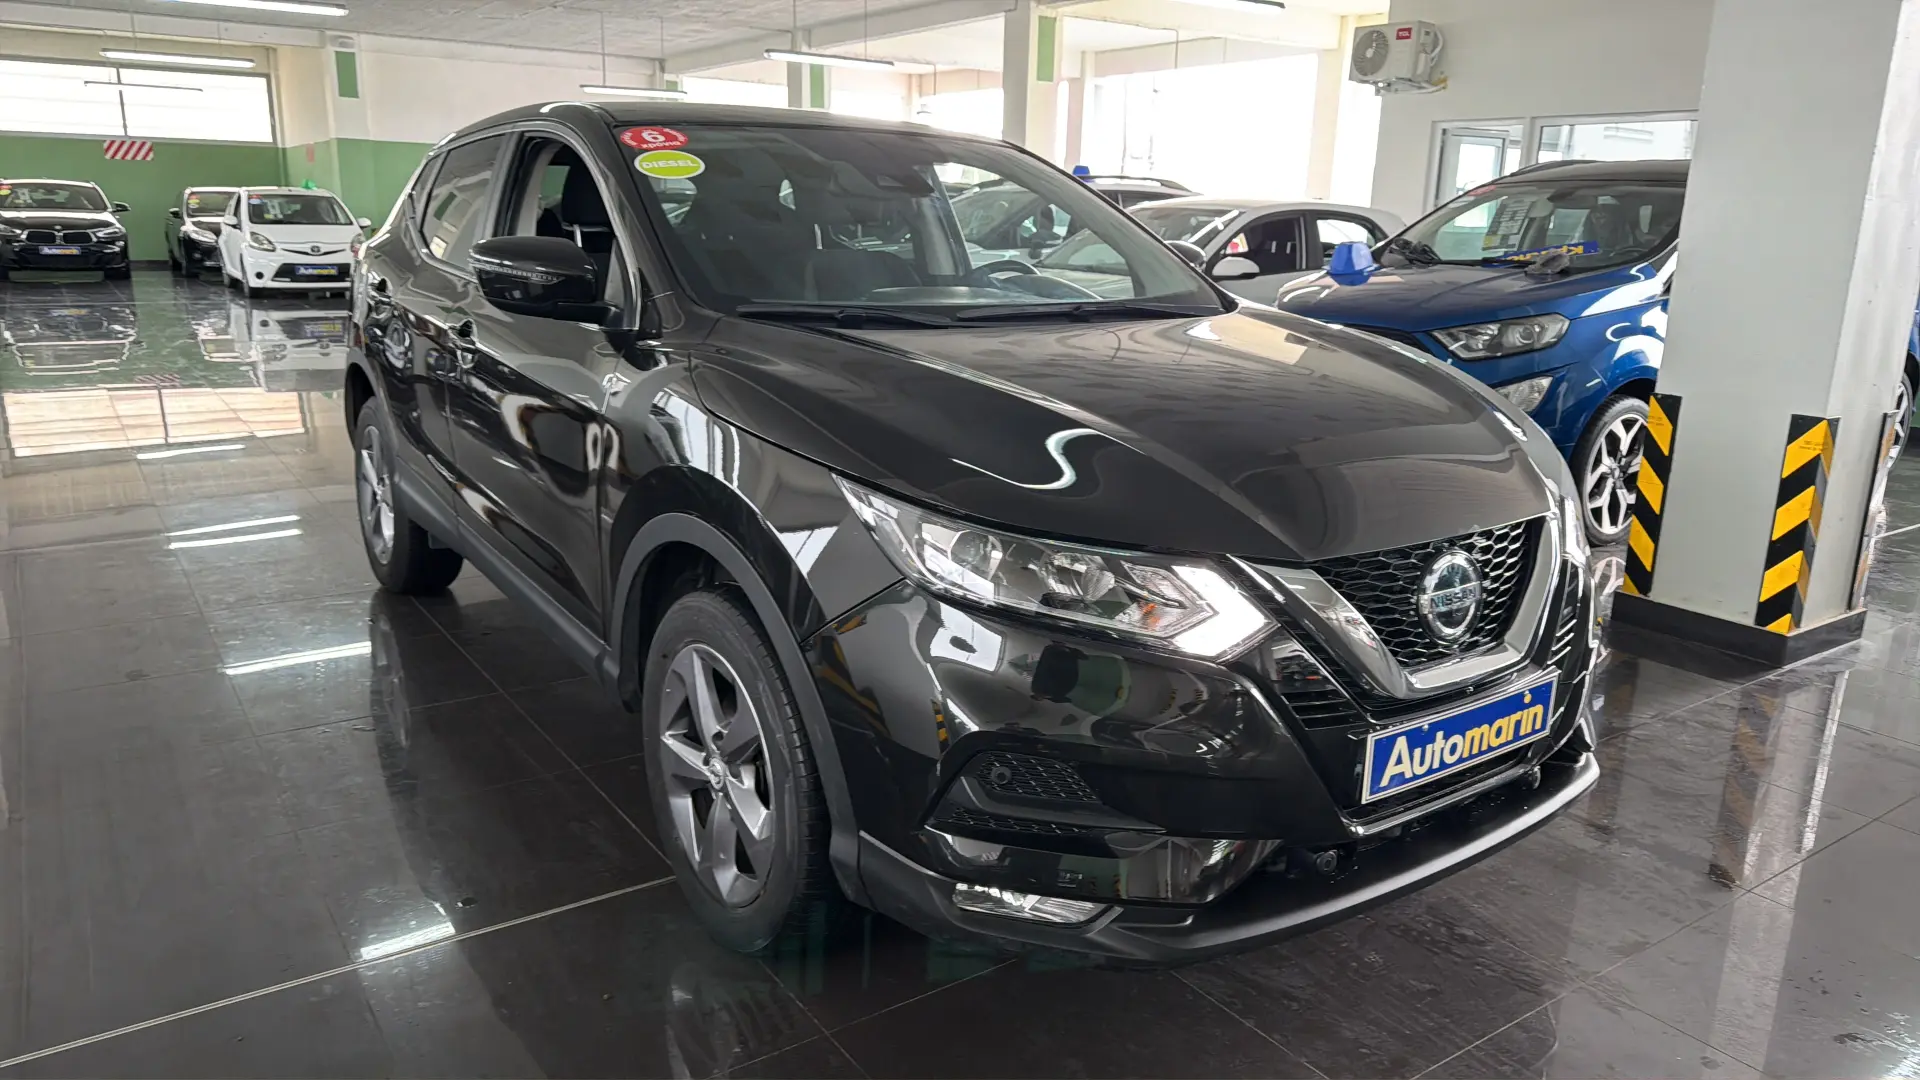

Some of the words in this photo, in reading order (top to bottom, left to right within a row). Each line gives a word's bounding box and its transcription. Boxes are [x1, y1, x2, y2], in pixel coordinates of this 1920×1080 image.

[640, 130, 666, 143] 6
[641, 160, 698, 169] DIESEL
[1430, 586, 1477, 609] NISSAN
[1379, 692, 1544, 788] Automarin
